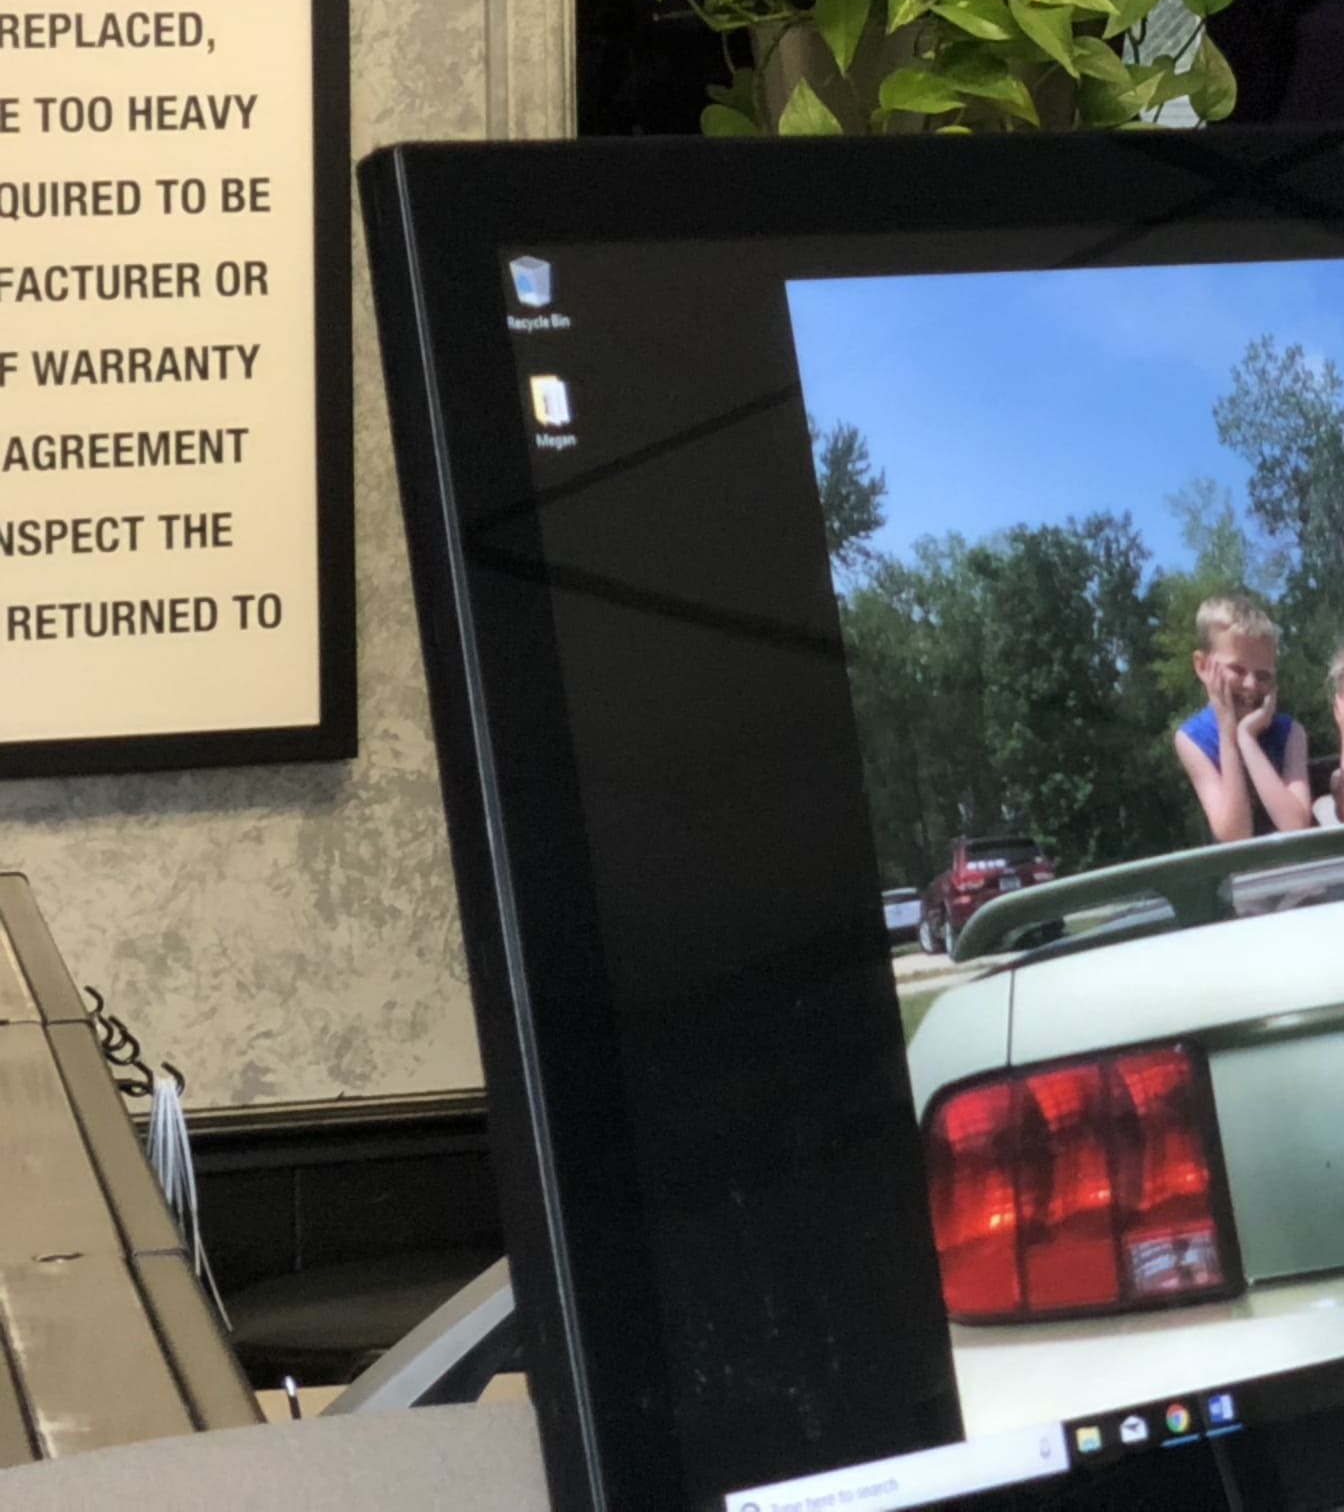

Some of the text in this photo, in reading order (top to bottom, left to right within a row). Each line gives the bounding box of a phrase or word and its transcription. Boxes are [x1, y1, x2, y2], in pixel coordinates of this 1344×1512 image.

[0, 12, 215, 54] REPLACED,
[34, 96, 113, 132] TOO
[128, 94, 258, 131] HEAVY
[0, 177, 271, 220] QUIRED TO BE
[215, 261, 268, 296] OR
[507, 314, 571, 332] Recycle Bin
[31, 344, 260, 386] WARRANTY
[2, 427, 249, 472] AGREEMENT
[158, 512, 233, 549] THE
[7, 592, 282, 641] RETURNED TO
